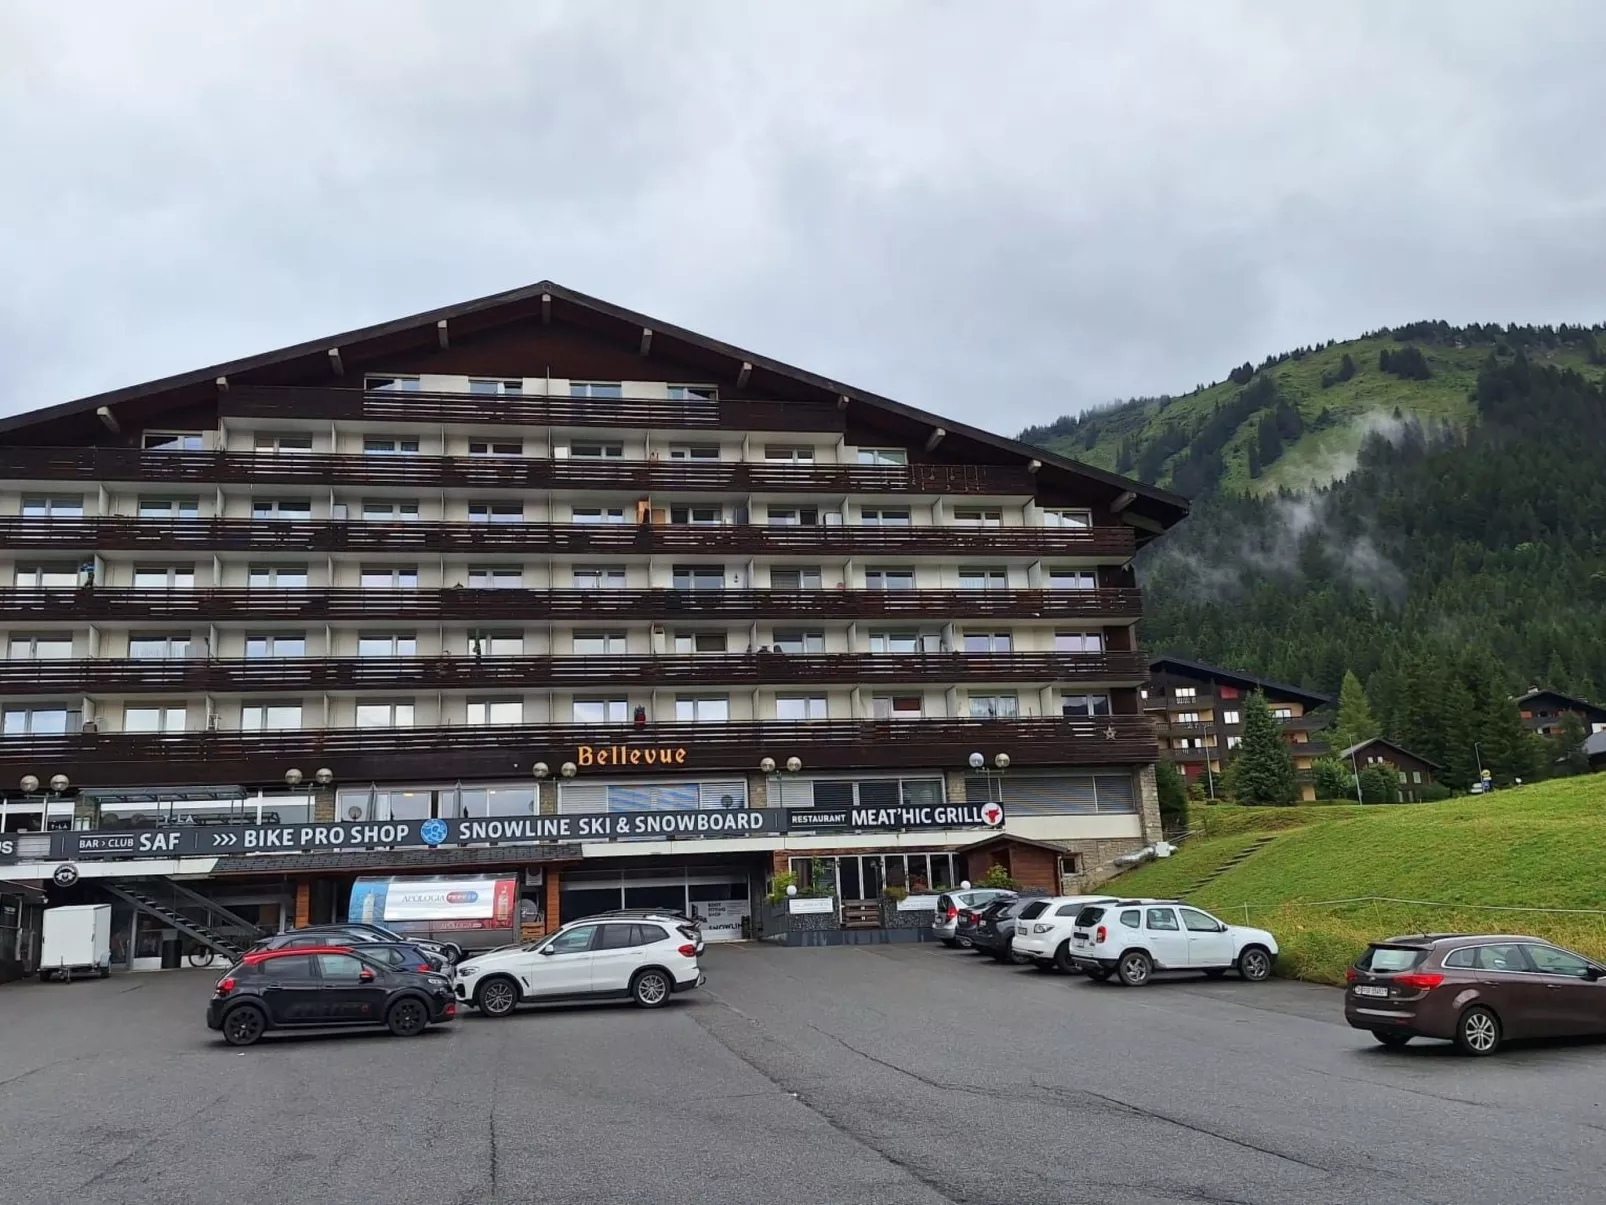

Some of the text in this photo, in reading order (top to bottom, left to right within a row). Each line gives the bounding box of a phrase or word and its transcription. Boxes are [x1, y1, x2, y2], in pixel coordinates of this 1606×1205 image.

[578, 745, 687, 766] Bellevue
[791, 814, 847, 824] RESTAURANT
[934, 806, 982, 824] GRILL
[458, 811, 764, 840] SNOWLINE SKI & SNOWBOARD
[79, 836, 134, 849] BAR CLUB
[139, 832, 181, 851] SAF
[243, 824, 409, 848] BIKE PRO SHOP
[0, 840, 14, 854] S
